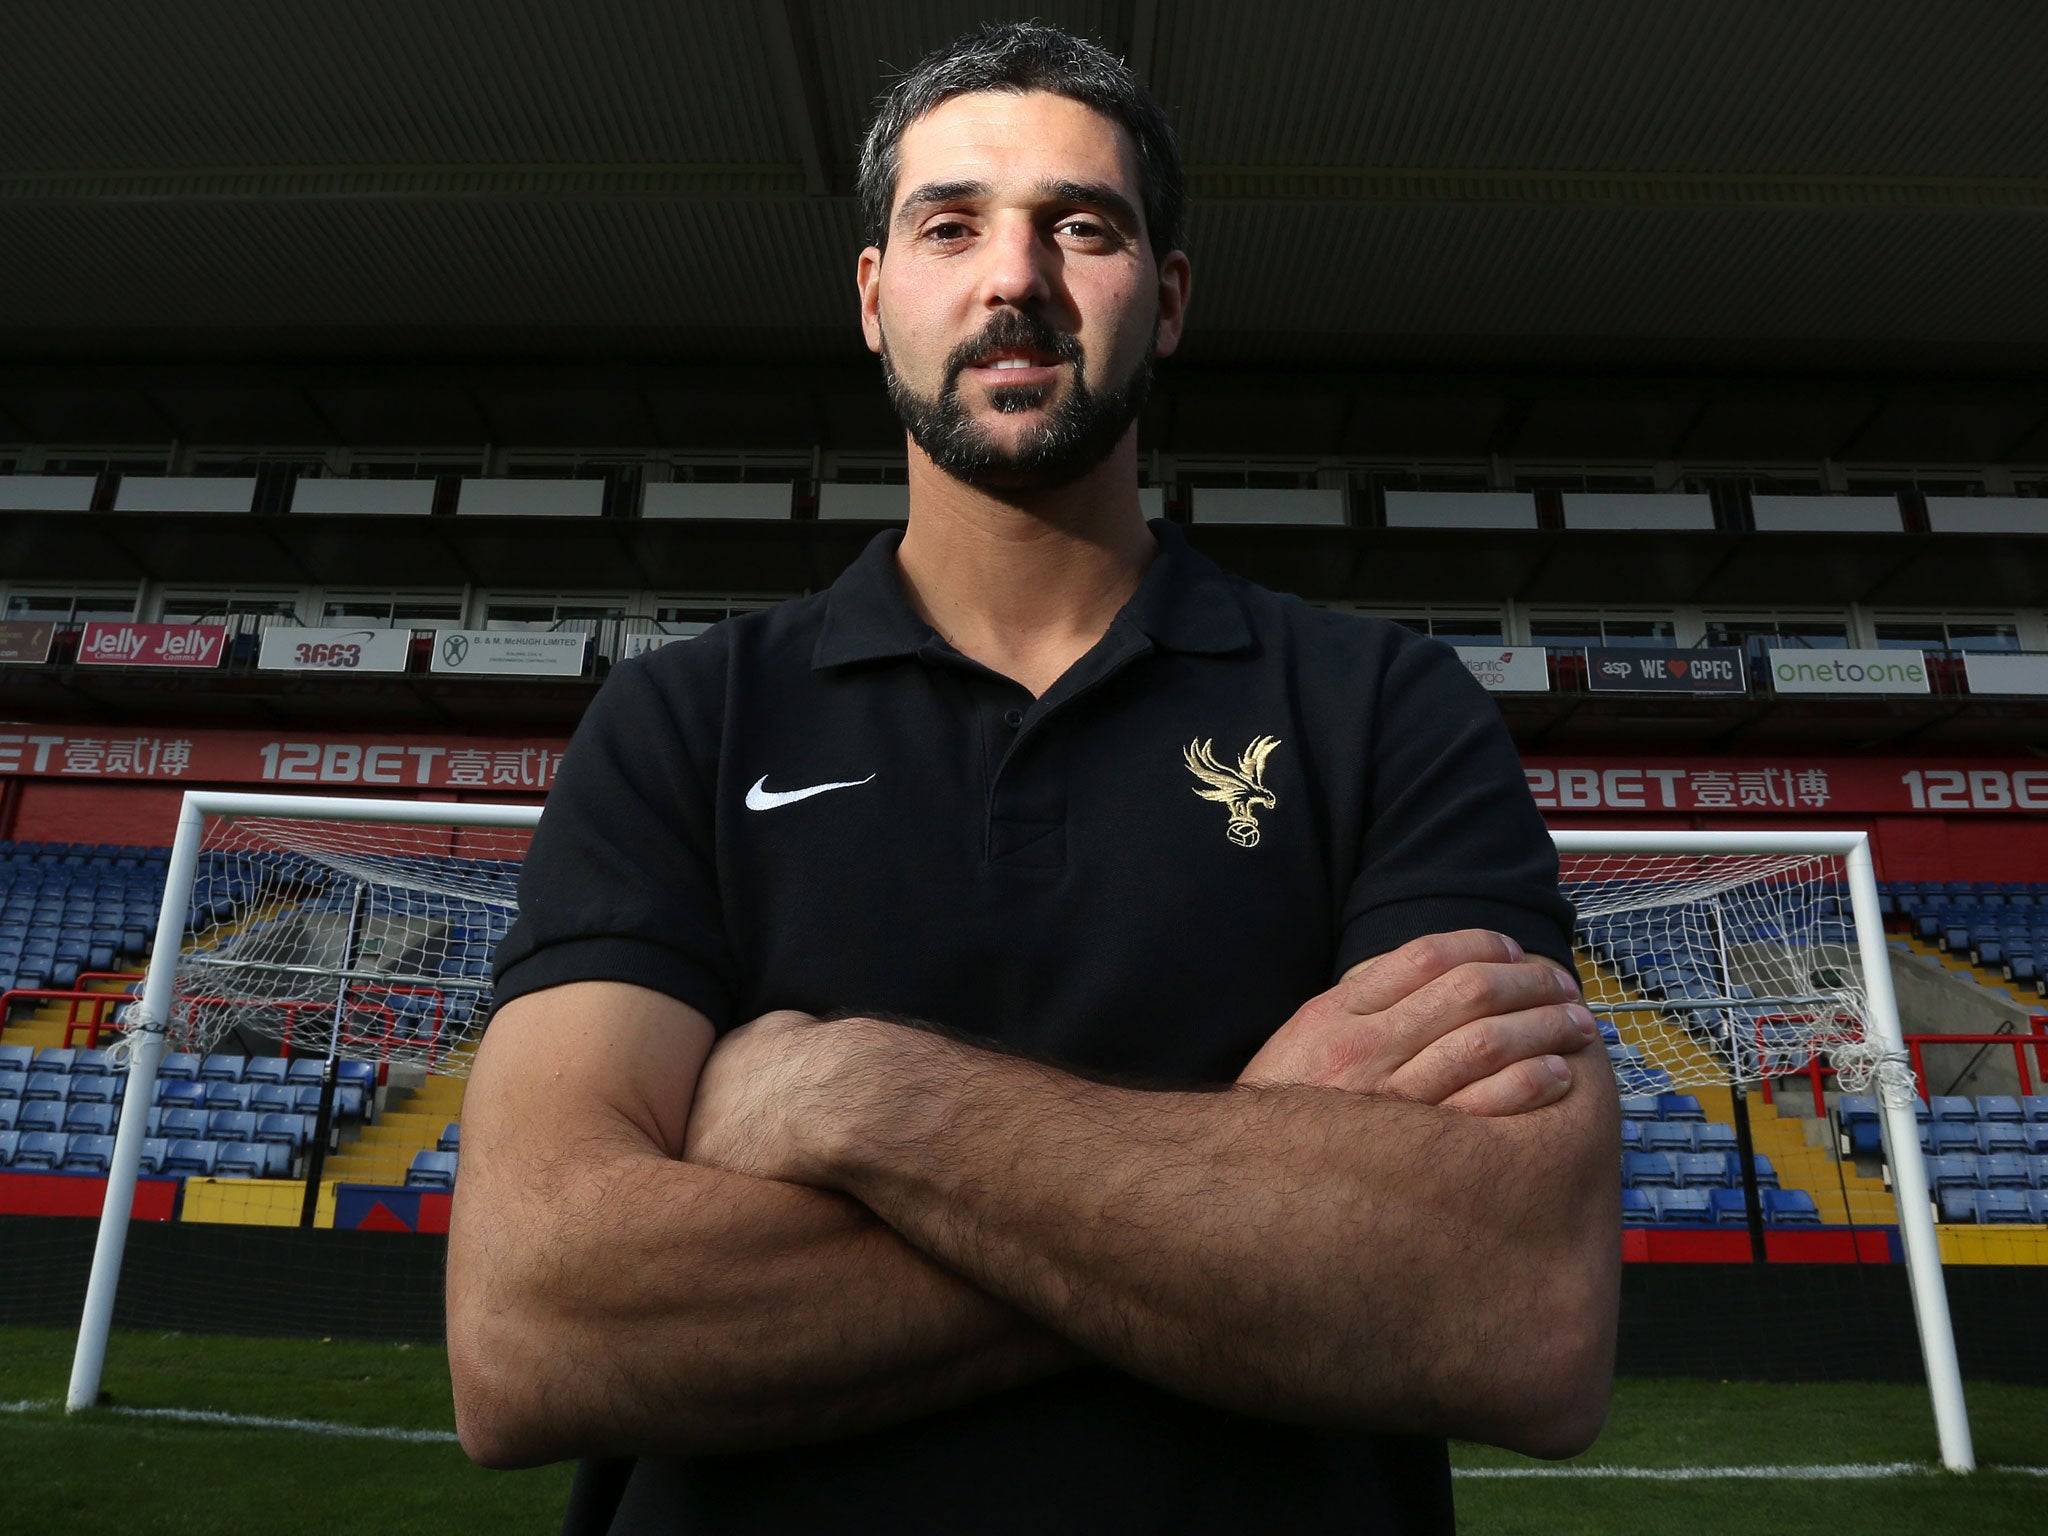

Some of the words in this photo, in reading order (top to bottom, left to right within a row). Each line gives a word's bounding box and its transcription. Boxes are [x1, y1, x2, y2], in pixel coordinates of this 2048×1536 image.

[86, 628, 147, 659] Jelly
[154, 629, 216, 661] Jelly
[484, 637, 490, 645] &
[504, 637, 541, 646] McHUGH
[543, 638, 577, 647] LIMITED
[293, 643, 361, 667] 3663
[1602, 661, 1632, 679] asp
[1640, 659, 1667, 679] WE
[1690, 660, 1733, 680] CPFC
[1777, 659, 1923, 683] onetoone
[64, 736, 193, 776] 壹贰博
[260, 741, 447, 785] 12BET
[1690, 767, 1831, 808] 壹贰博
